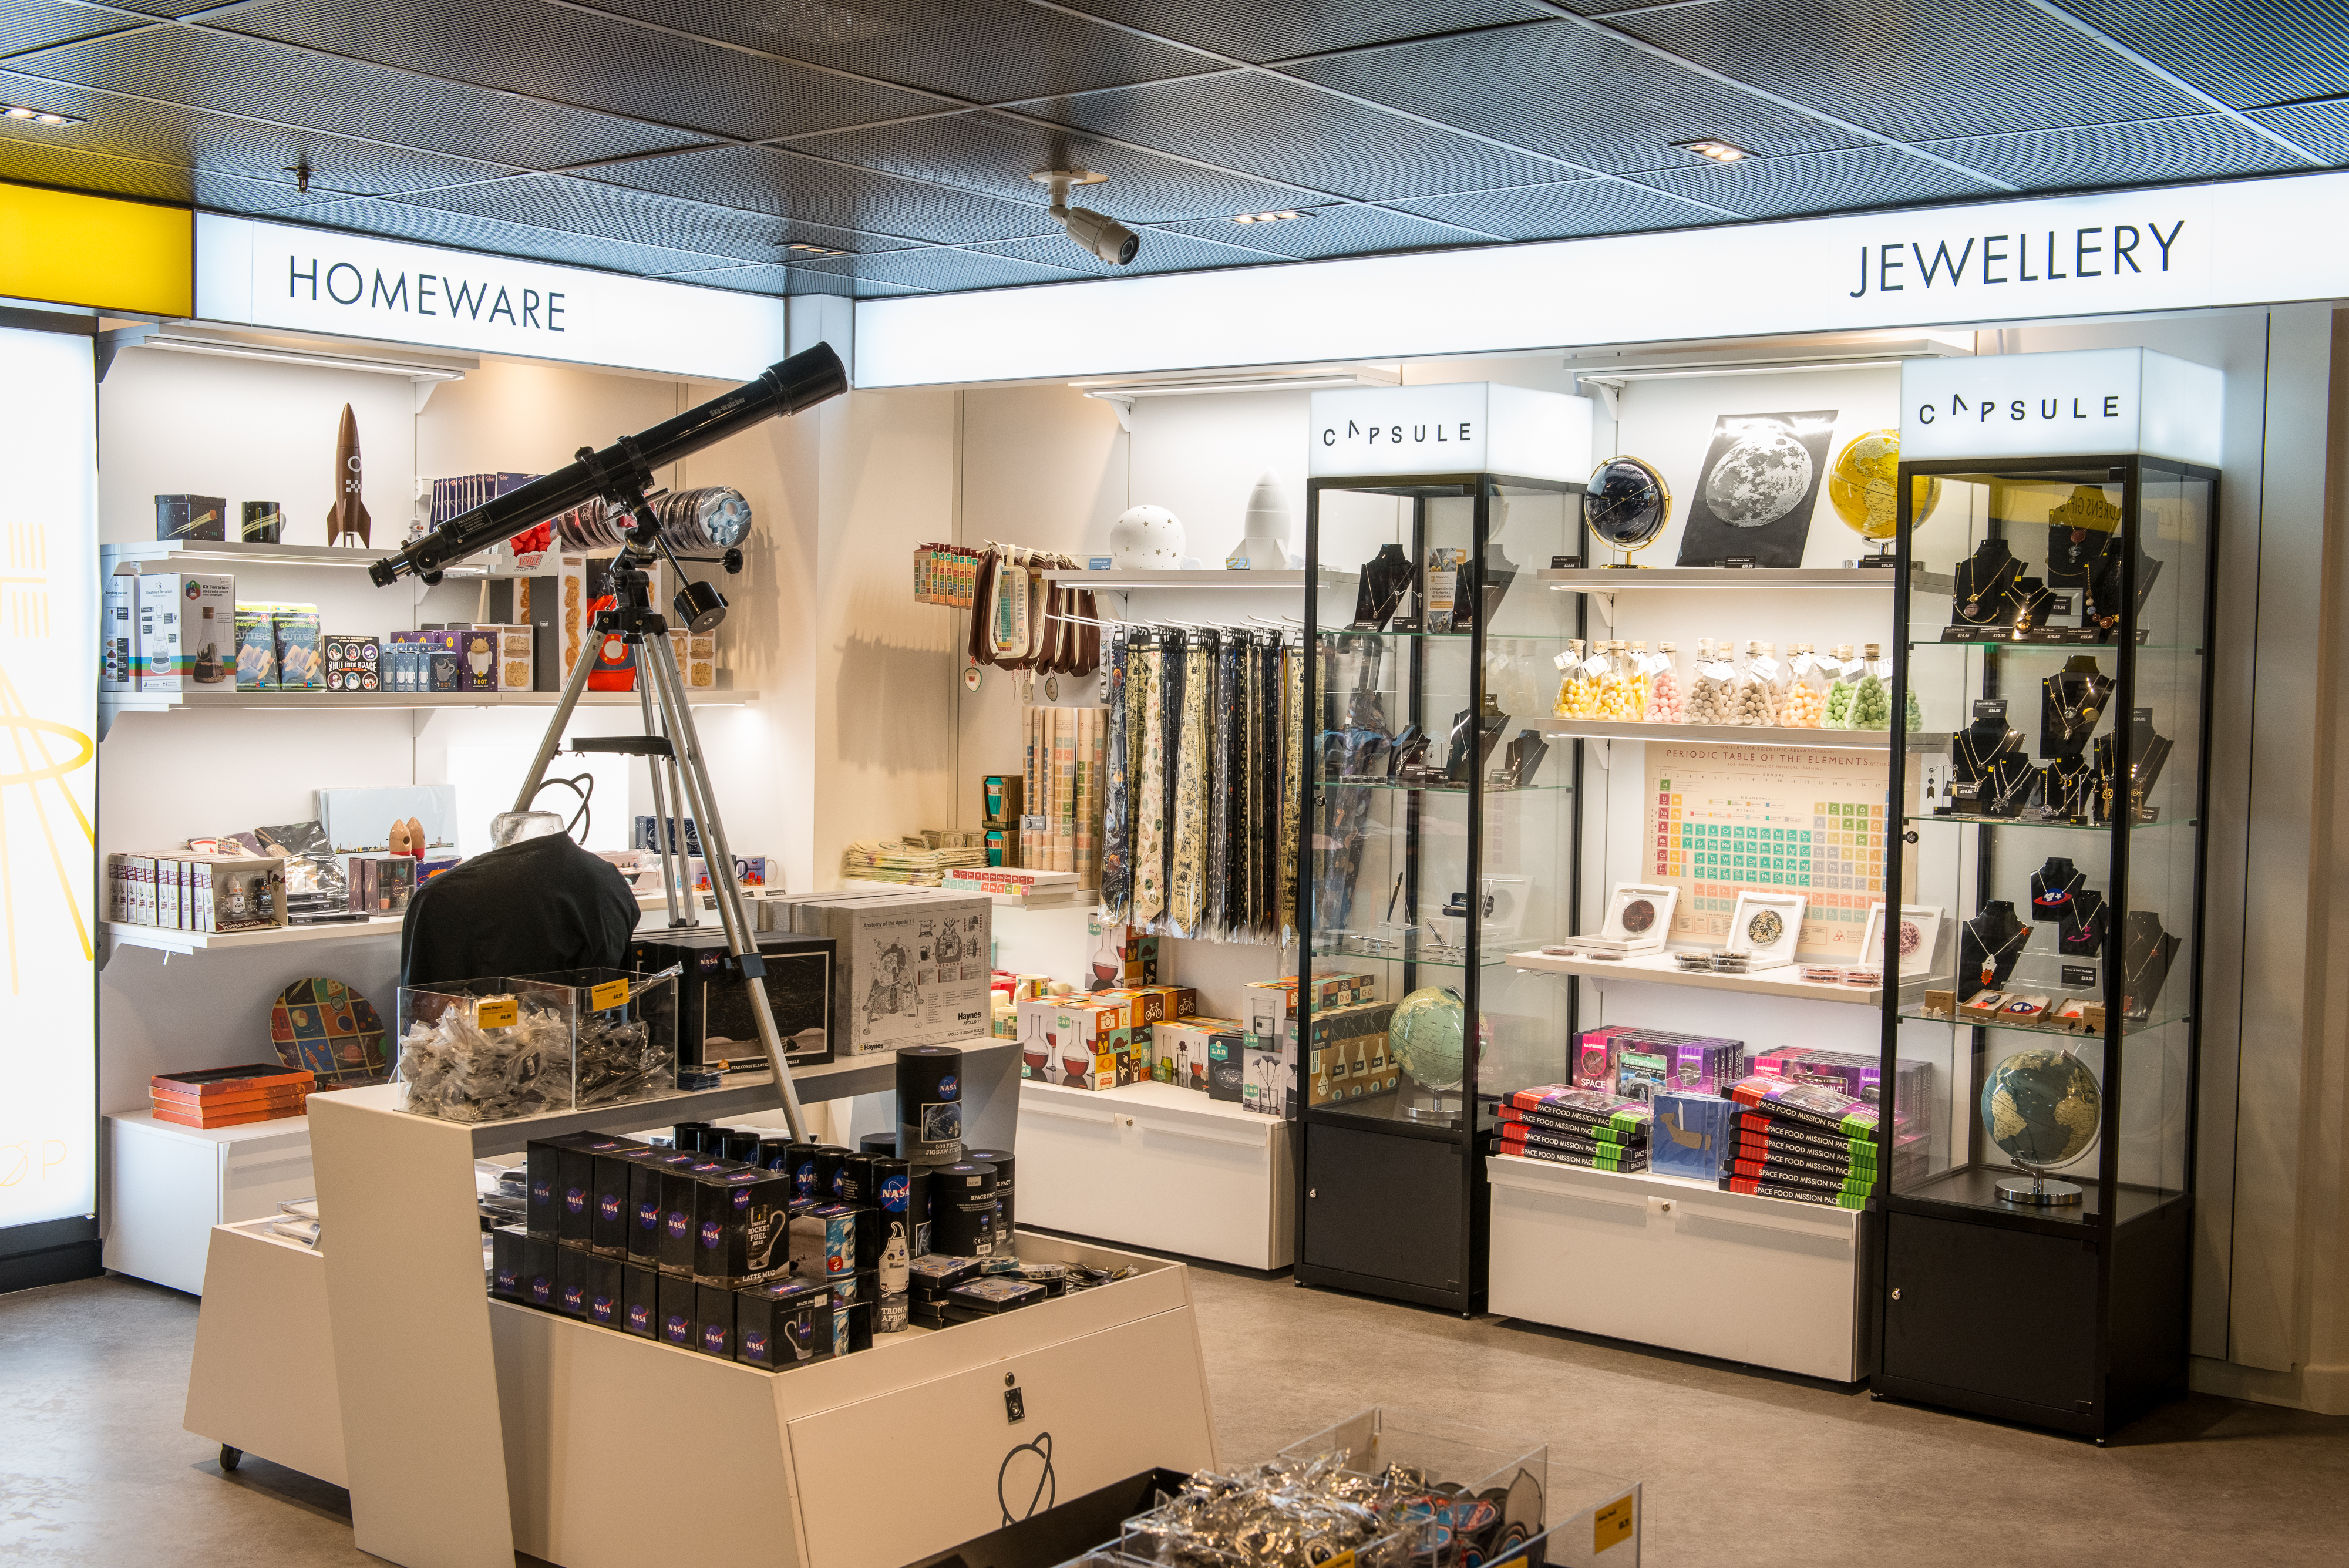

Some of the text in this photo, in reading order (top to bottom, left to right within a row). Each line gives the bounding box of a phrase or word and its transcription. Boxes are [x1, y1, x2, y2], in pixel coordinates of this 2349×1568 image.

[1849, 220, 2185, 298] JEWELLERY
[290, 255, 564, 332] HOMEWARE
[709, 397, 745, 416] Sky-Watcher
[1920, 393, 2119, 425] CAPSULE
[1324, 420, 1470, 446] CAPSULE
[458, 512, 482, 524] TELESCOPE
[519, 555, 541, 567] SPACE
[329, 661, 343, 671] SHOT
[358, 662, 377, 673] SPACE
[1667, 750, 1718, 759] PERIODIC
[1723, 752, 1755, 761] TABLE
[1808, 756, 1868, 765] ELEMENTS
[958, 1011, 981, 1021] Haynes
[1623, 1054, 1666, 1070] ASTRONAUT
[1581, 1078, 1605, 1089] SPACE
[1553, 1108, 1570, 1116] FOOD
[1571, 1112, 1596, 1122] MISSION
[1598, 1118, 1613, 1126] PACK
[1776, 1106, 1796, 1116] FOOD
[1798, 1113, 1826, 1125] MISSION
[1828, 1121, 1844, 1130] PACK
[1557, 1155, 1580, 1164] MISSION
[1581, 1158, 1596, 1166] PACK
[883, 1189, 910, 1197] NASA
[1773, 1190, 1793, 1198] FOOD
[1795, 1193, 1822, 1202] MISSION
[567, 1196, 583, 1204] NASA
[602, 1203, 617, 1212] NASA
[640, 1211, 657, 1220] NASA
[669, 1220, 685, 1230] NASA
[748, 1224, 770, 1234] ROCKET
[702, 1230, 719, 1239] NASA
[742, 1274, 762, 1282] LATTE
[566, 1294, 580, 1303] NASA
[594, 1304, 610, 1314] NASA
[631, 1313, 646, 1323] NASA
[881, 1313, 907, 1322] APRON
[668, 1324, 685, 1334] NASA
[706, 1333, 723, 1343] NASA
[747, 1341, 763, 1351] NASA
